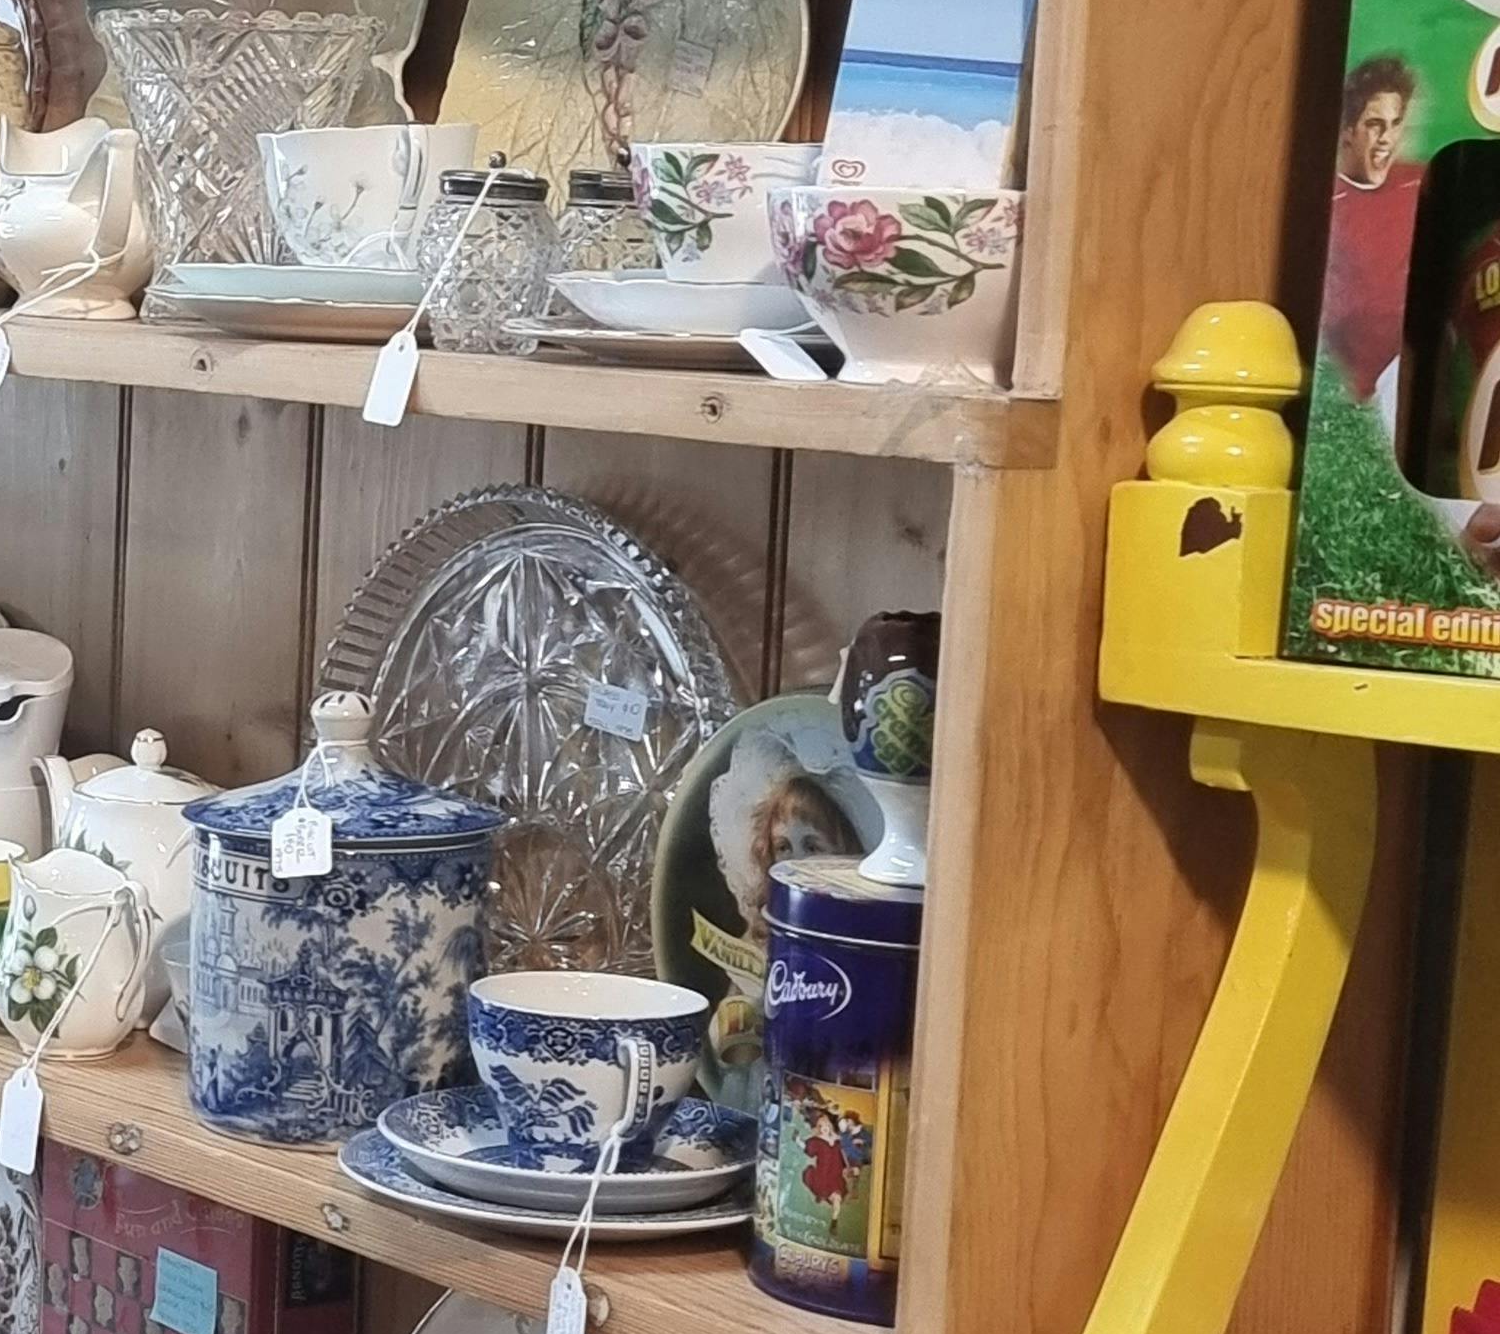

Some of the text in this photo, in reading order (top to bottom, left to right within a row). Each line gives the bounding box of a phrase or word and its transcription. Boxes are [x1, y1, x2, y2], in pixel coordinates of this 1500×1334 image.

[1316, 602, 1425, 635] special
[194, 847, 290, 893] ISCUIT
[769, 959, 839, 1007] Cadbury
